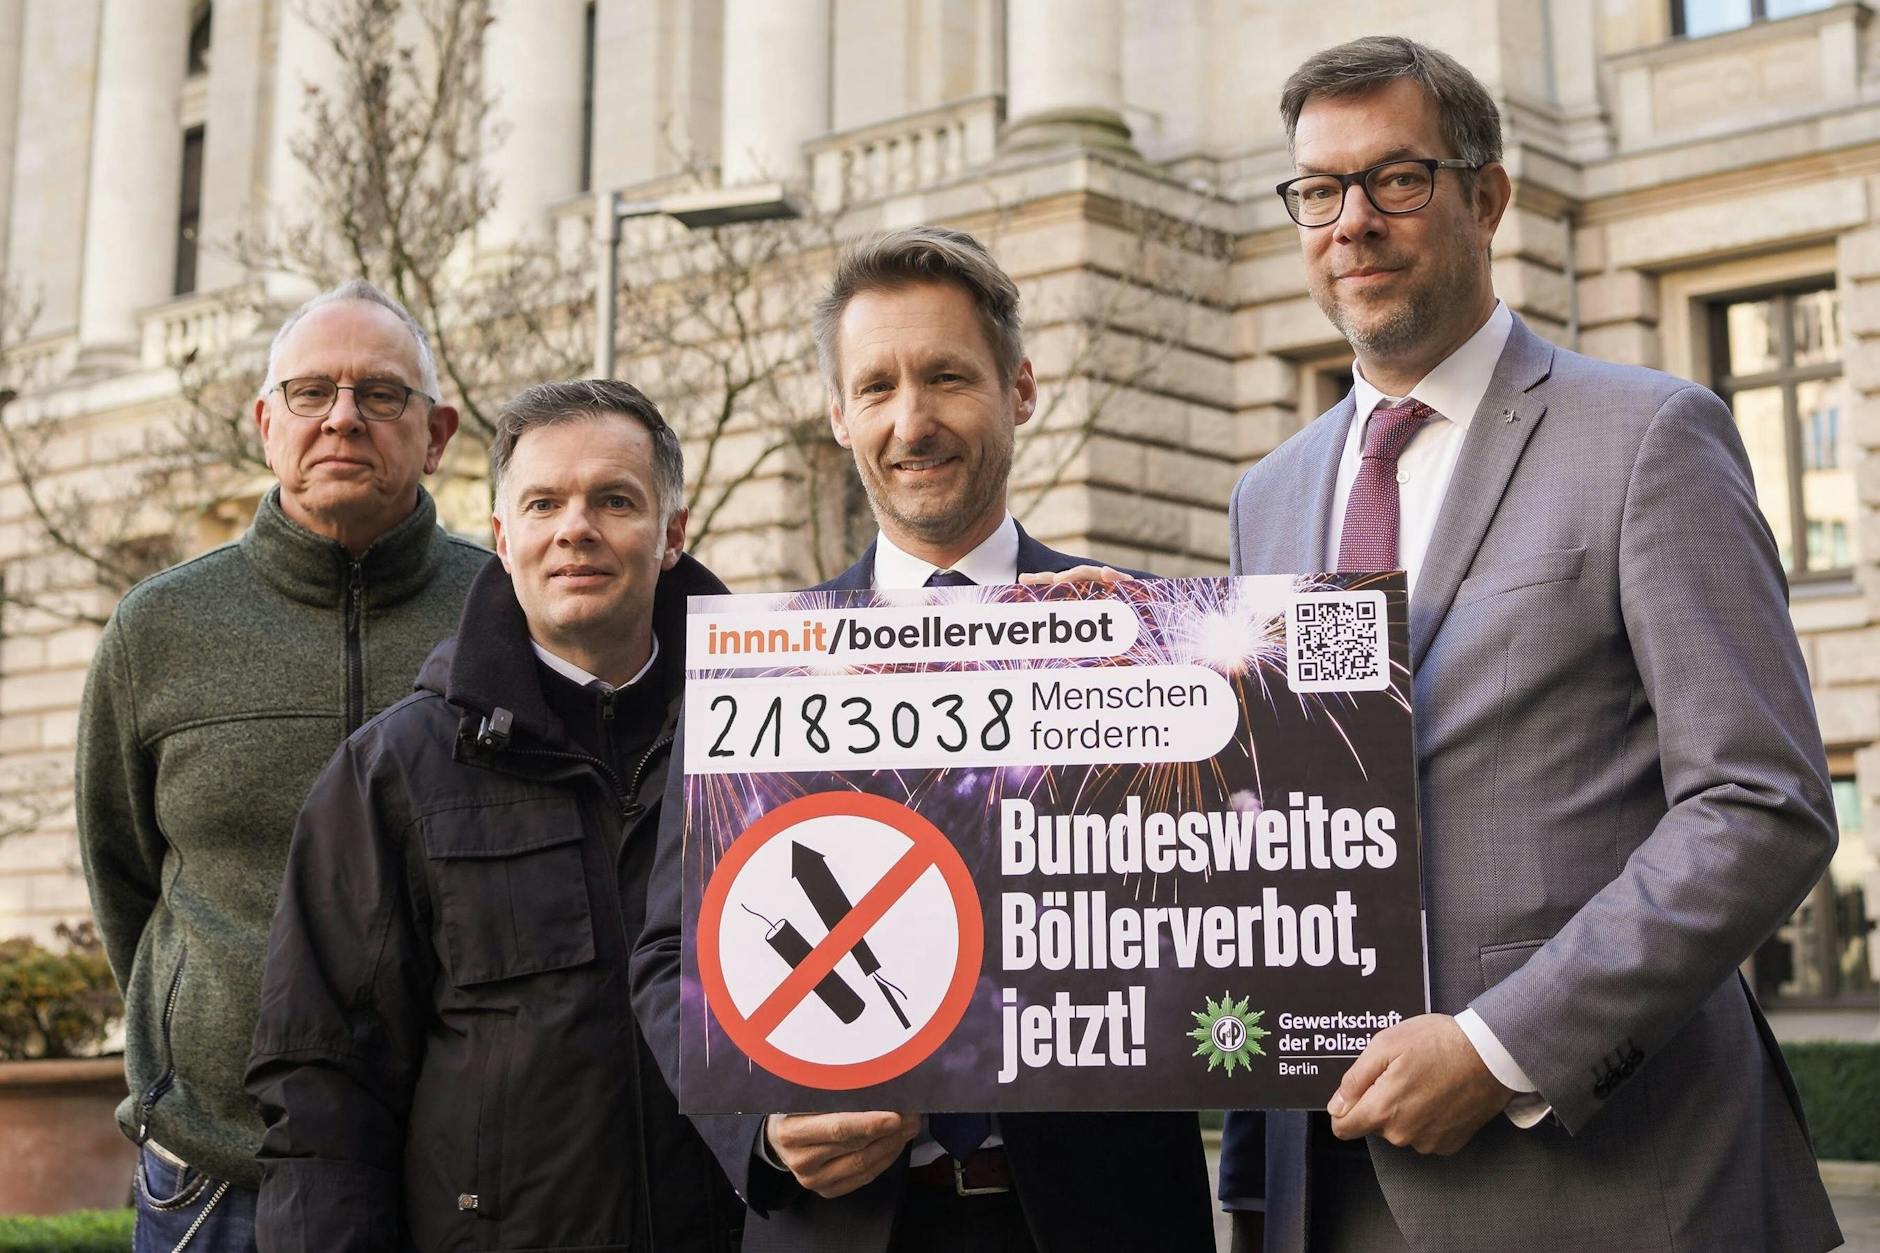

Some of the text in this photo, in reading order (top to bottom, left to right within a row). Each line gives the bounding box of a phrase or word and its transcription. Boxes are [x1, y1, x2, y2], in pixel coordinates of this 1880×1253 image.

[708, 612, 1114, 655] innn.it/boellerverbot
[1030, 679, 1208, 712] Menschen
[708, 688, 1014, 758] 2183038
[1030, 719, 1171, 753] fordern:
[1000, 792, 1398, 876] Bundesweites
[1000, 888, 1377, 977] Böllerverbot,
[998, 985, 1148, 1084] jetzt!
[1278, 1010, 1402, 1030] Gewerkschaft
[1278, 1032, 1371, 1052] der Polizei
[1279, 1062, 1319, 1076] Berlin
